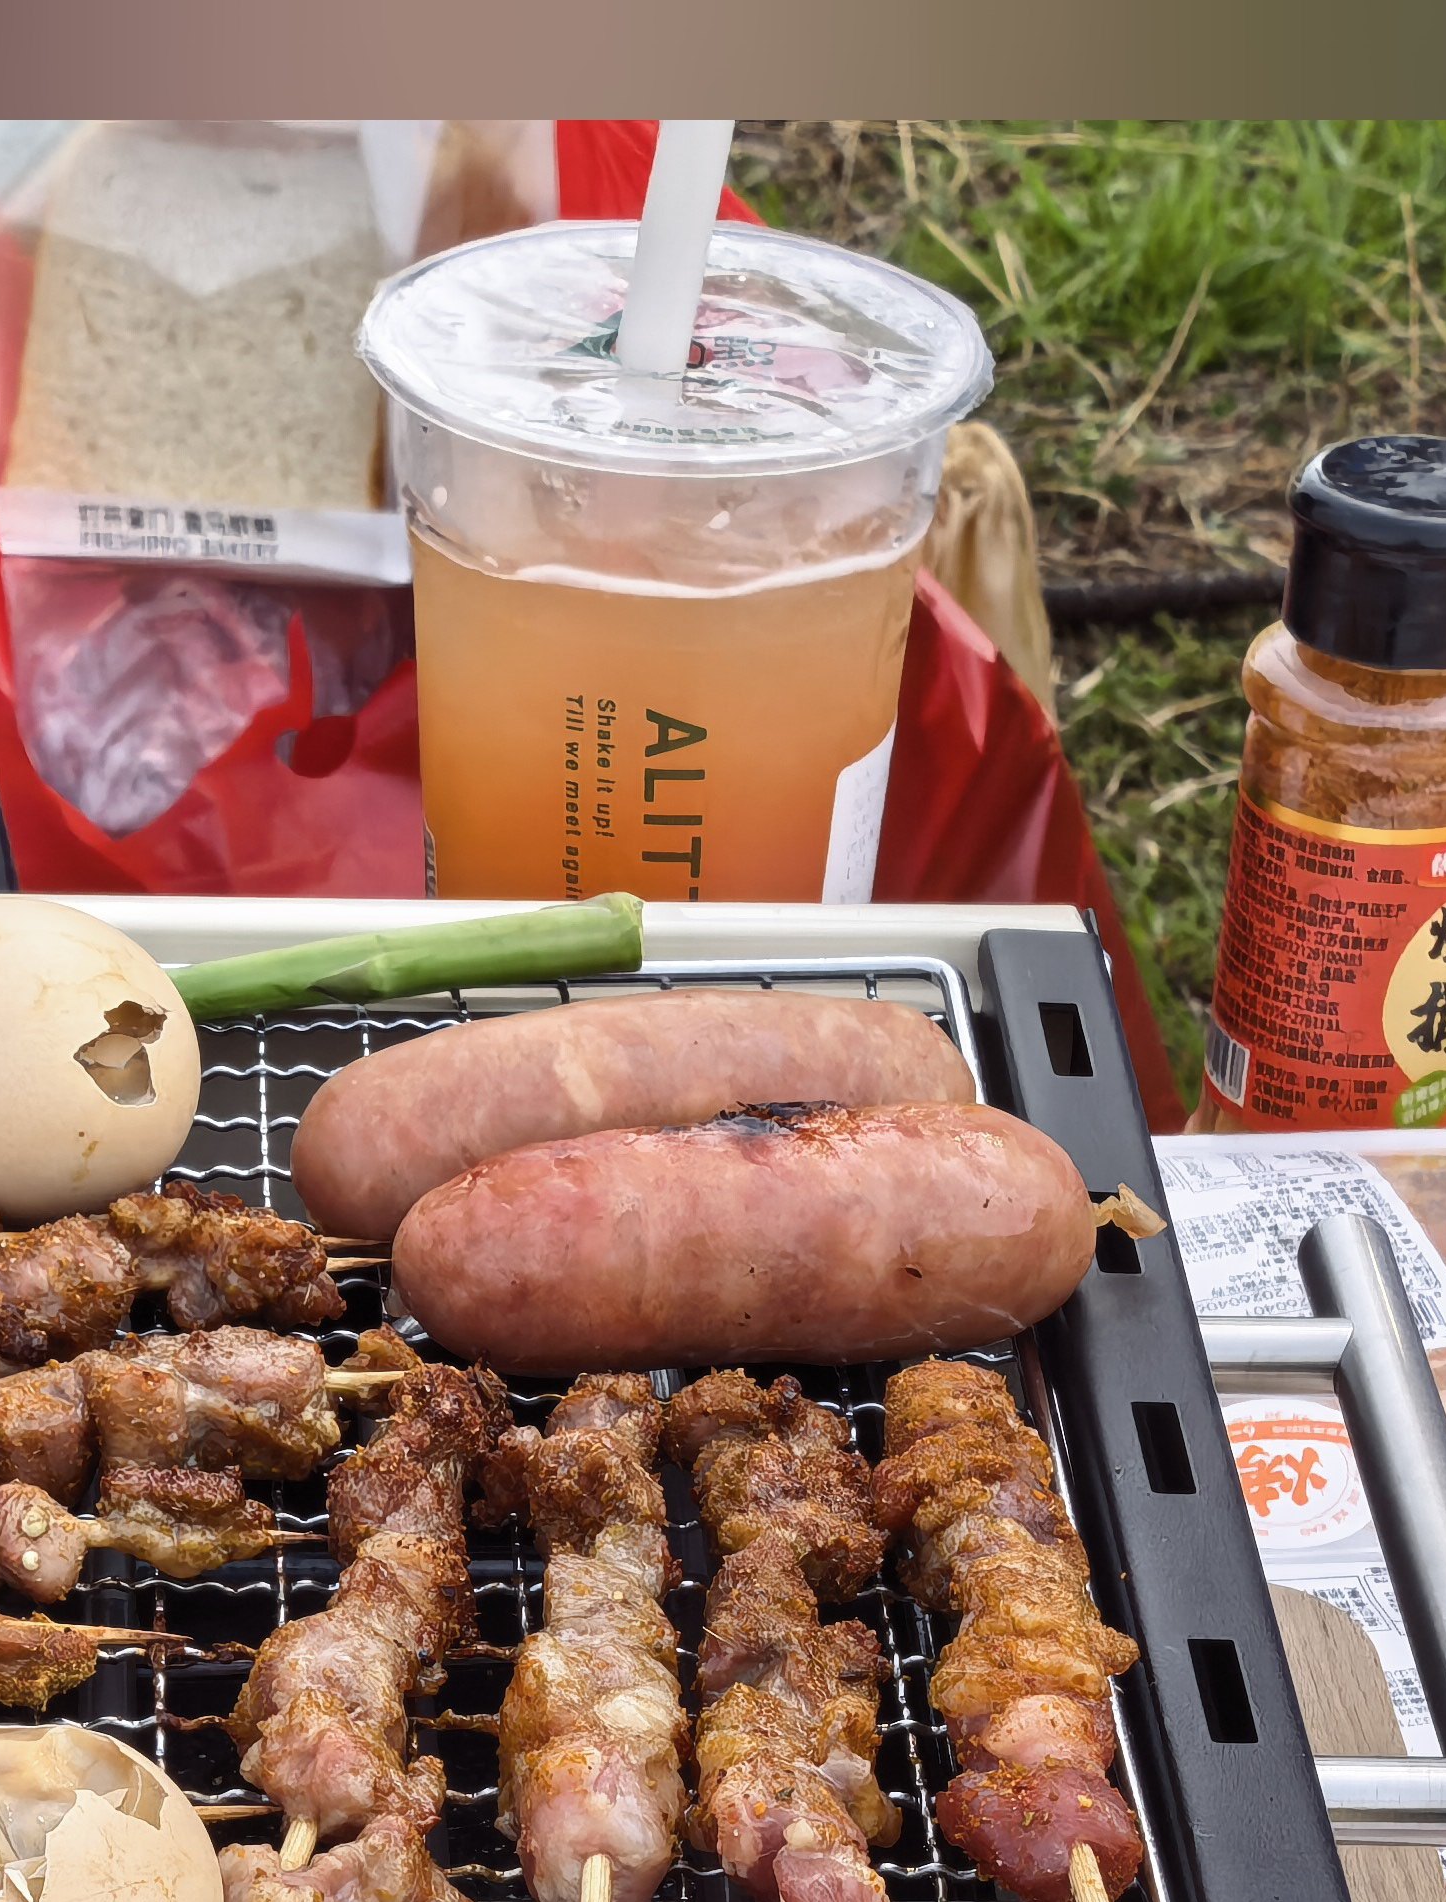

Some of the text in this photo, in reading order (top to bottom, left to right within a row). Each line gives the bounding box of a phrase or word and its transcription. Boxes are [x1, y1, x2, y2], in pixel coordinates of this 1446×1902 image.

[565, 694, 584, 732] Till
[596, 698, 617, 768] Shake
[564, 741, 579, 771] we
[565, 780, 582, 836] meet
[592, 803, 615, 838] up!
